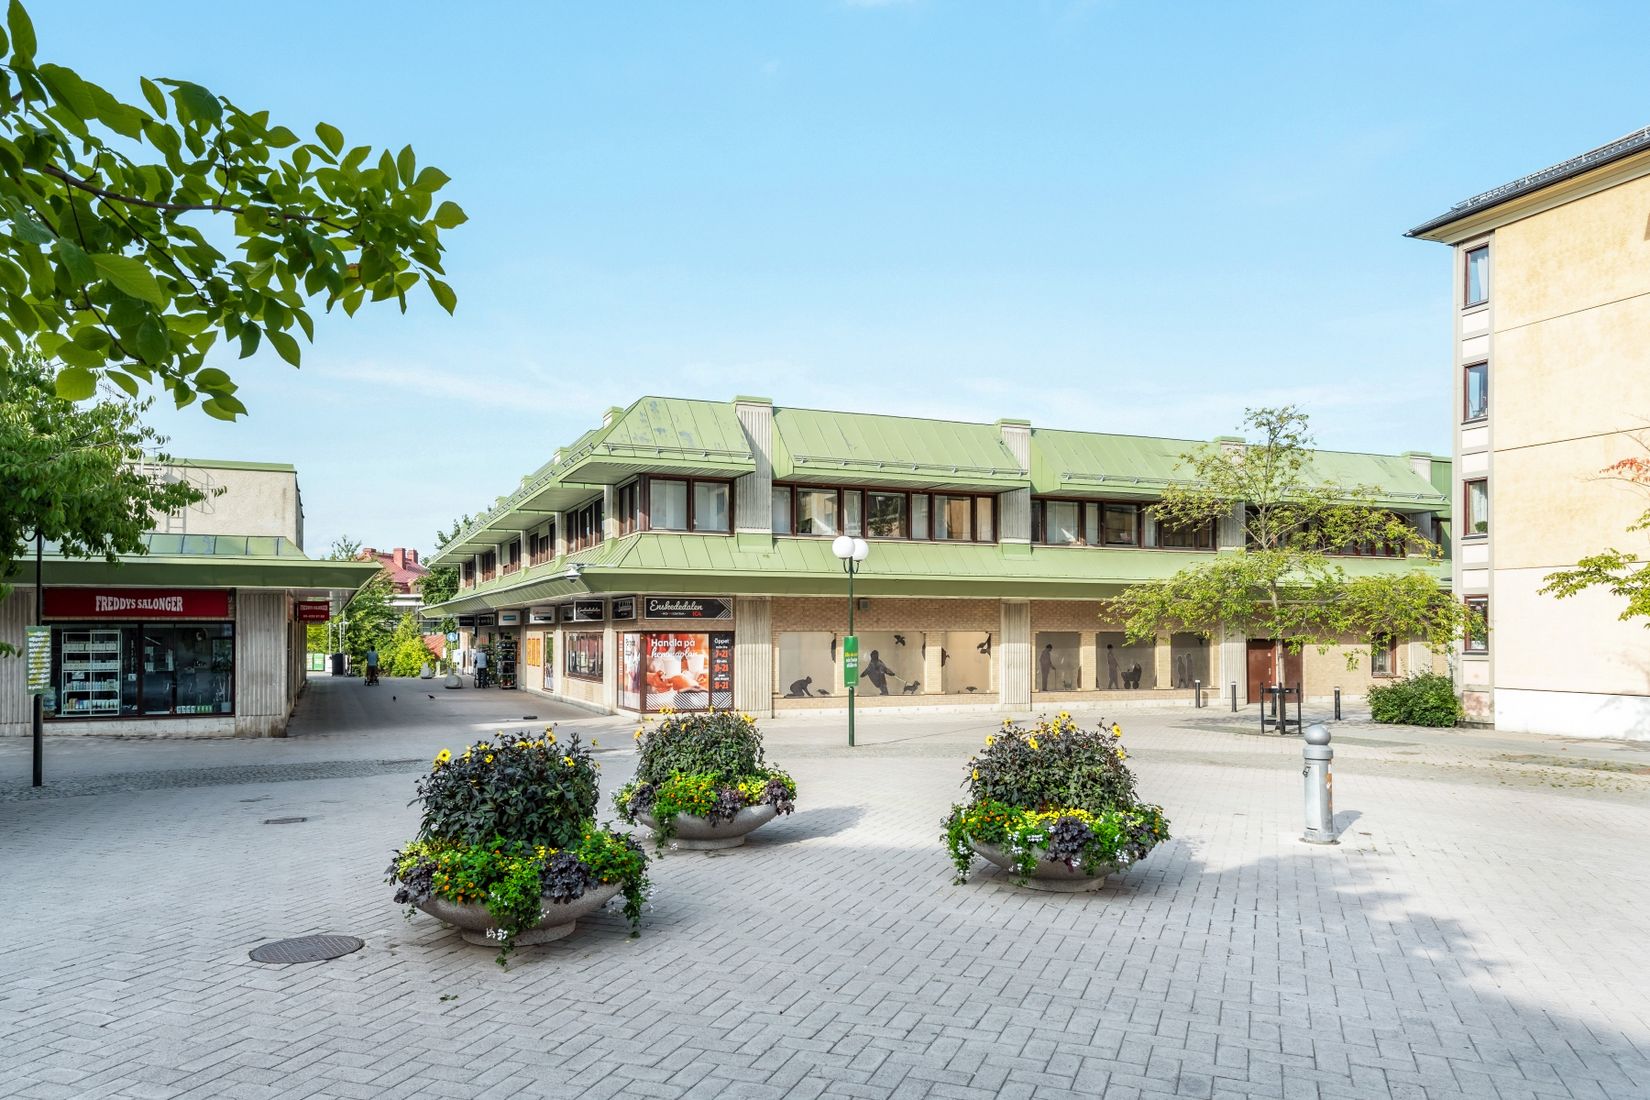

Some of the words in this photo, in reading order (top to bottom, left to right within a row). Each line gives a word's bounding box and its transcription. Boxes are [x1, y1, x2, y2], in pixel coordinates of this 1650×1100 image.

[95, 595, 136, 612] FREDDYS
[137, 596, 184, 612] SALONGER
[649, 599, 704, 611] Enskededalen
[651, 638, 683, 647] Handla
[683, 637, 696, 649] på
[713, 637, 730, 645] Öppet
